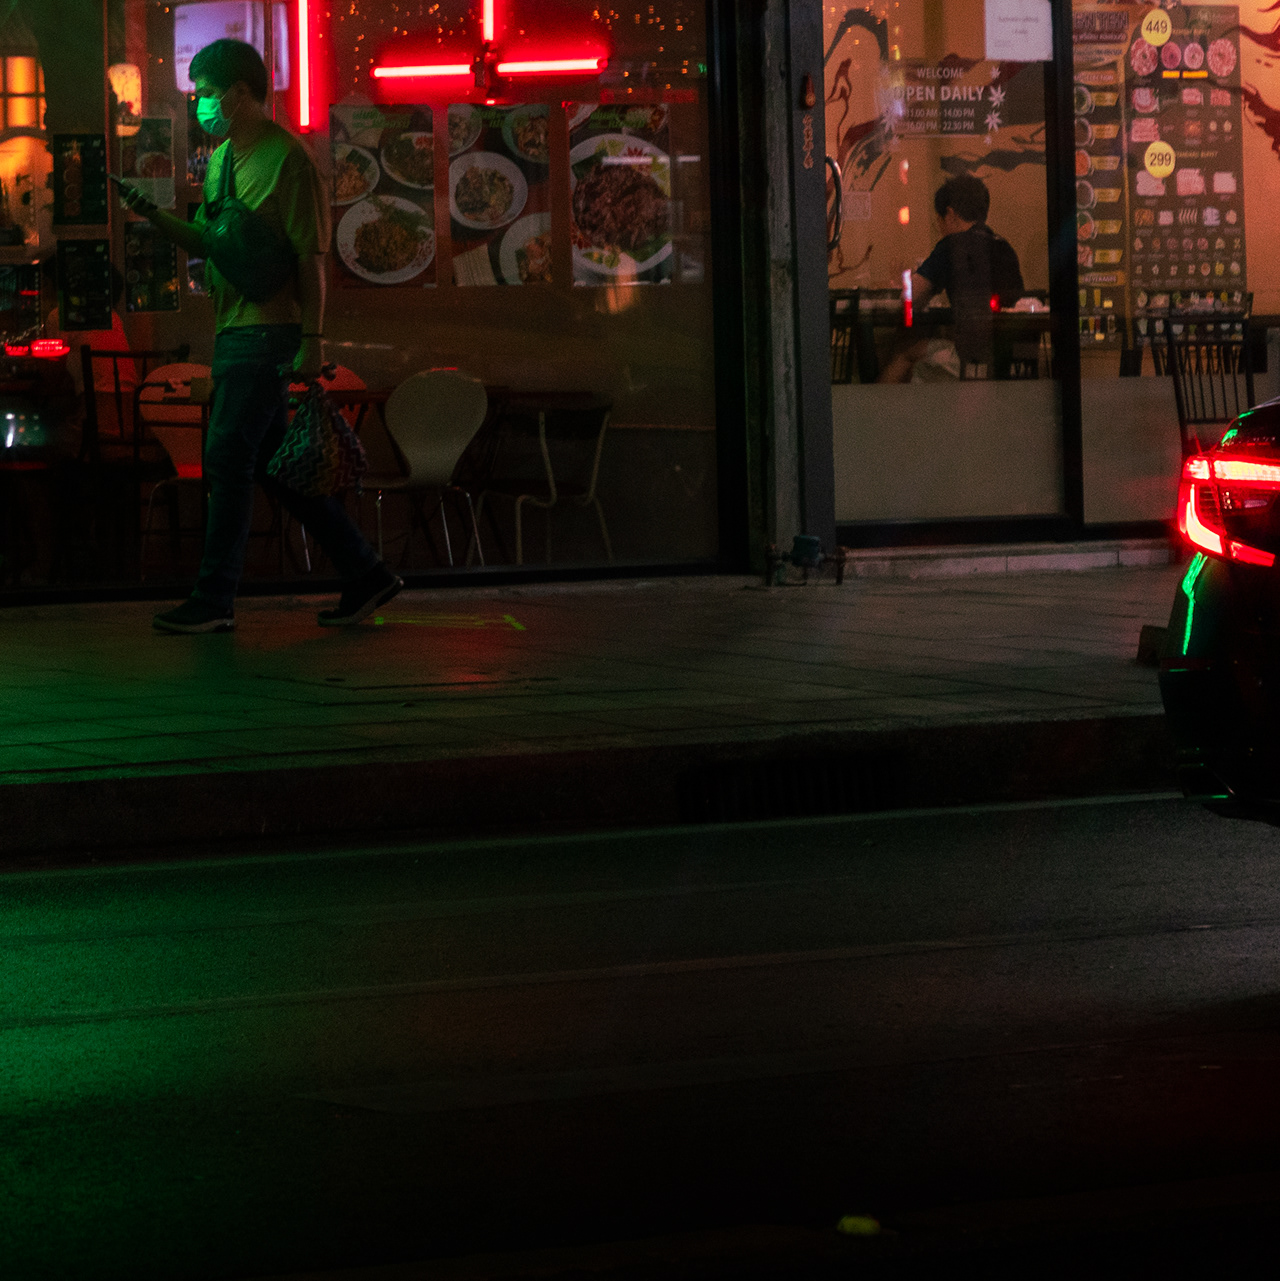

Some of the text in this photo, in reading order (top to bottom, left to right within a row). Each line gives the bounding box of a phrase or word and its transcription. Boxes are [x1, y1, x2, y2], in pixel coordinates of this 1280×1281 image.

[1145, 19, 1168, 35] 449
[916, 67, 964, 79] WELCOME
[940, 85, 985, 101] DAILY
[1149, 152, 1172, 167] 299
